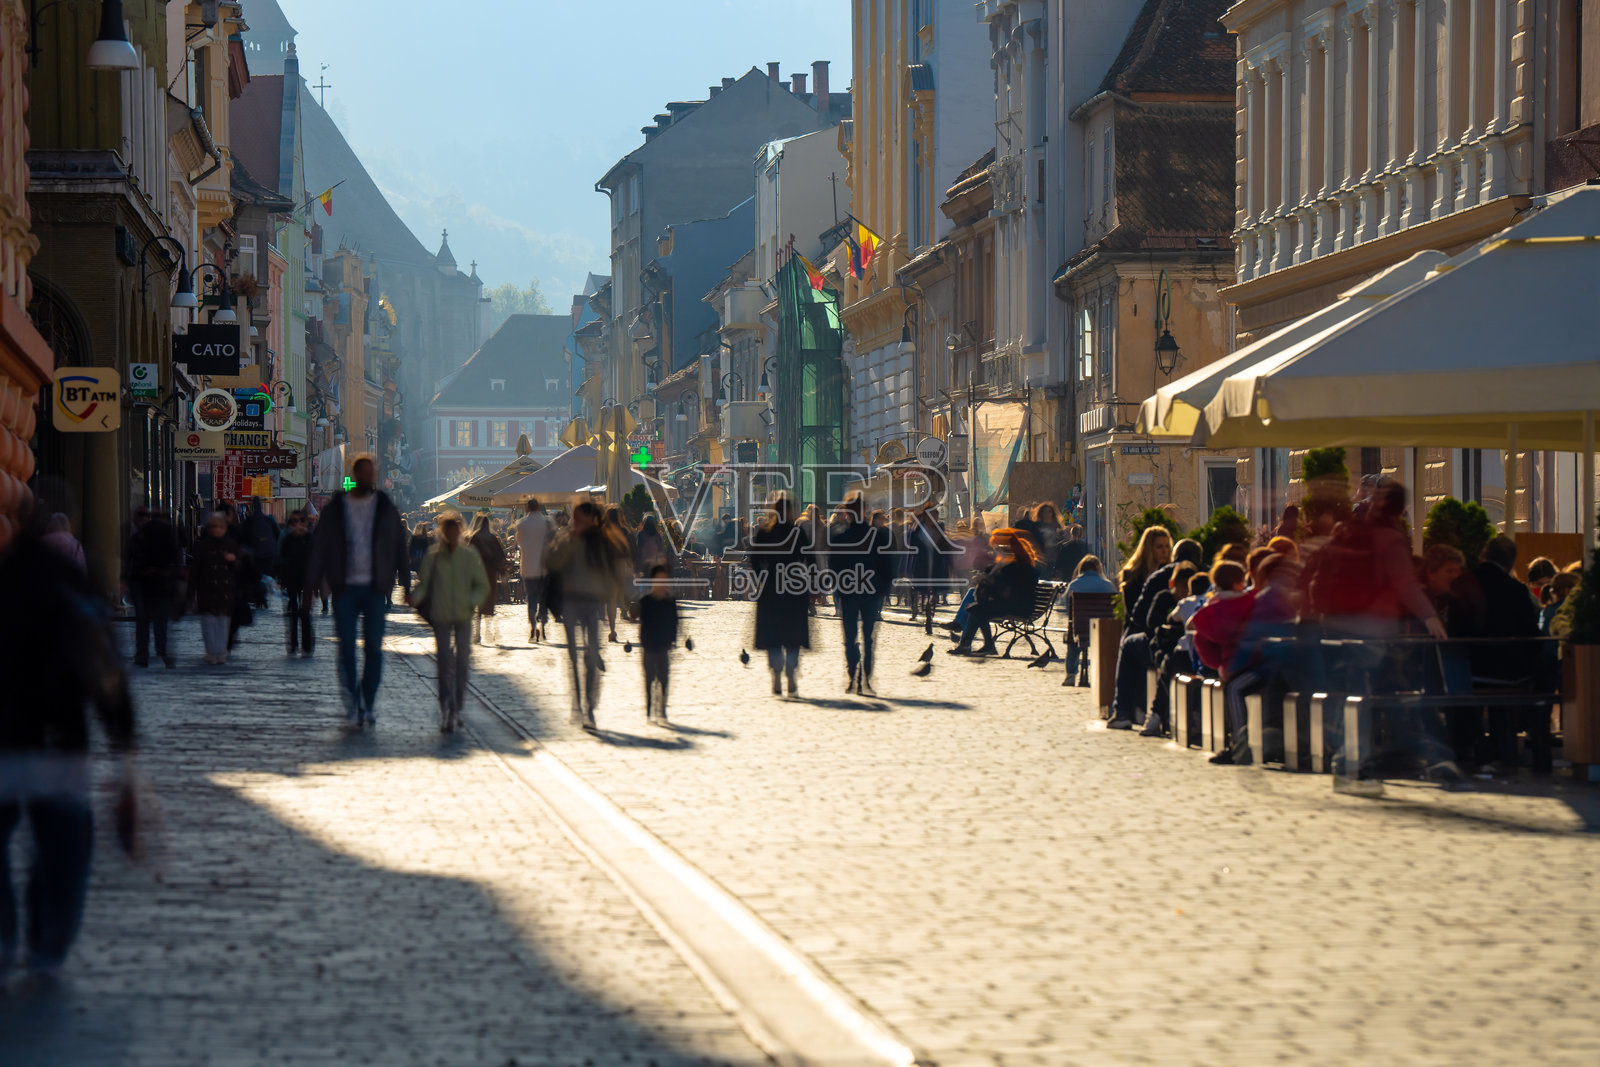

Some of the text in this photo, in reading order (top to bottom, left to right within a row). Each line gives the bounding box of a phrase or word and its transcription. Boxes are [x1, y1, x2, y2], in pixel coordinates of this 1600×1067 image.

[191, 343, 235, 356] CATO
[65, 387, 117, 402] BT ATM
[232, 419, 259, 428] Holidays
[263, 455, 293, 464] CAFE
[919, 451, 940, 459] TELEFON
